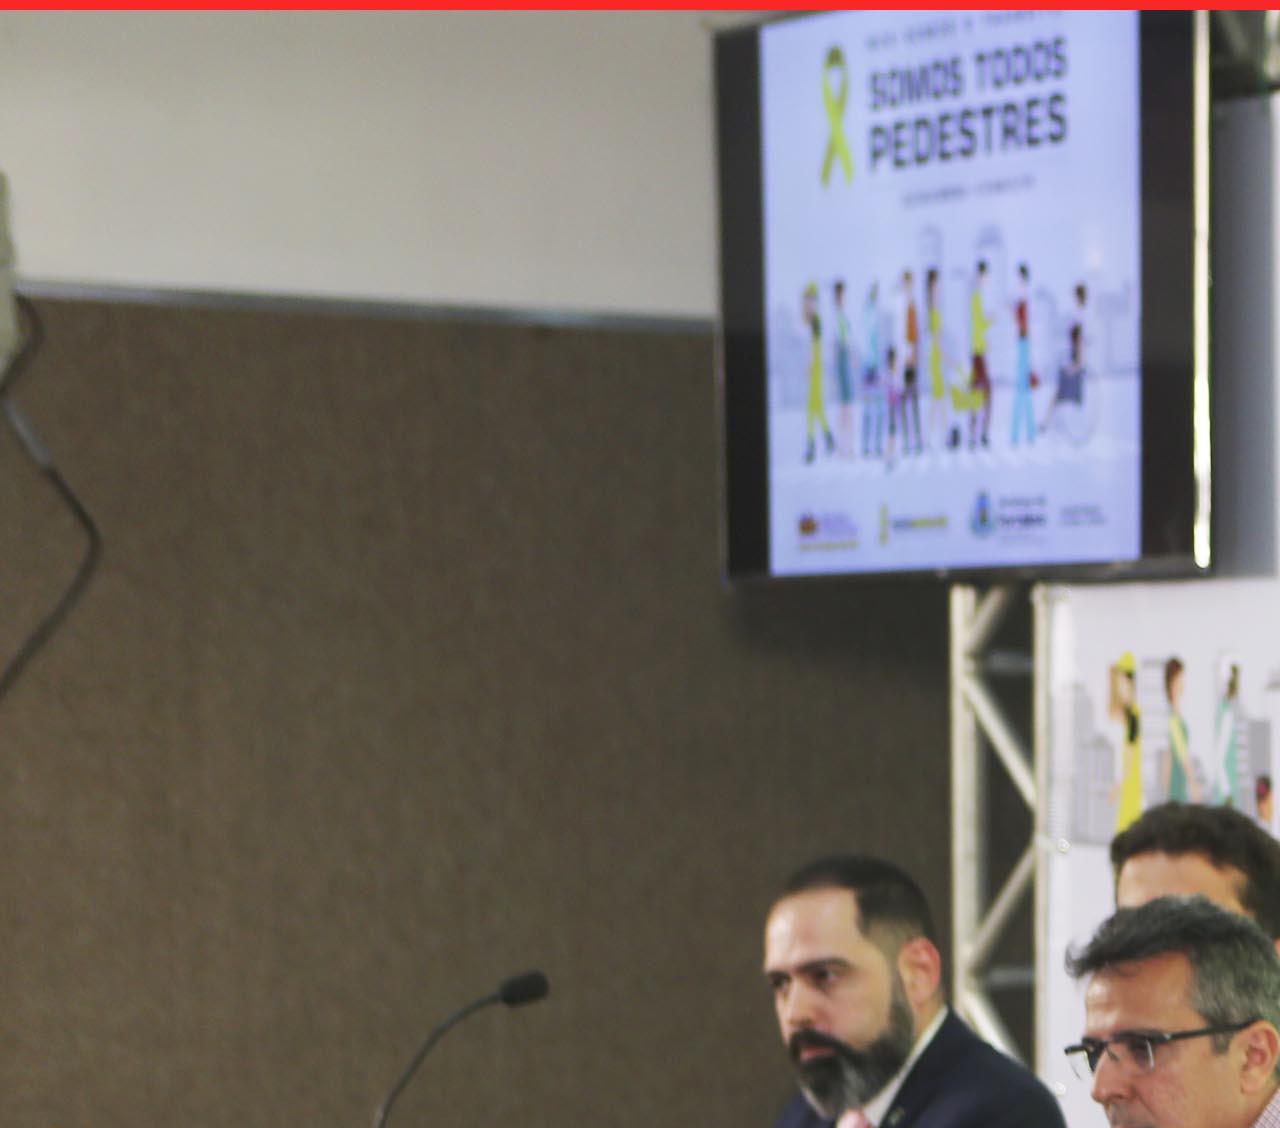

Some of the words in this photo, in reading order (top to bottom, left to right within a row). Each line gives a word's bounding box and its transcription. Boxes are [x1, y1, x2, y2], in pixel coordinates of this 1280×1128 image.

[869, 57, 964, 112] SOMOS
[975, 36, 1068, 92] TODOS
[868, 92, 1069, 172] PEDESTRES
